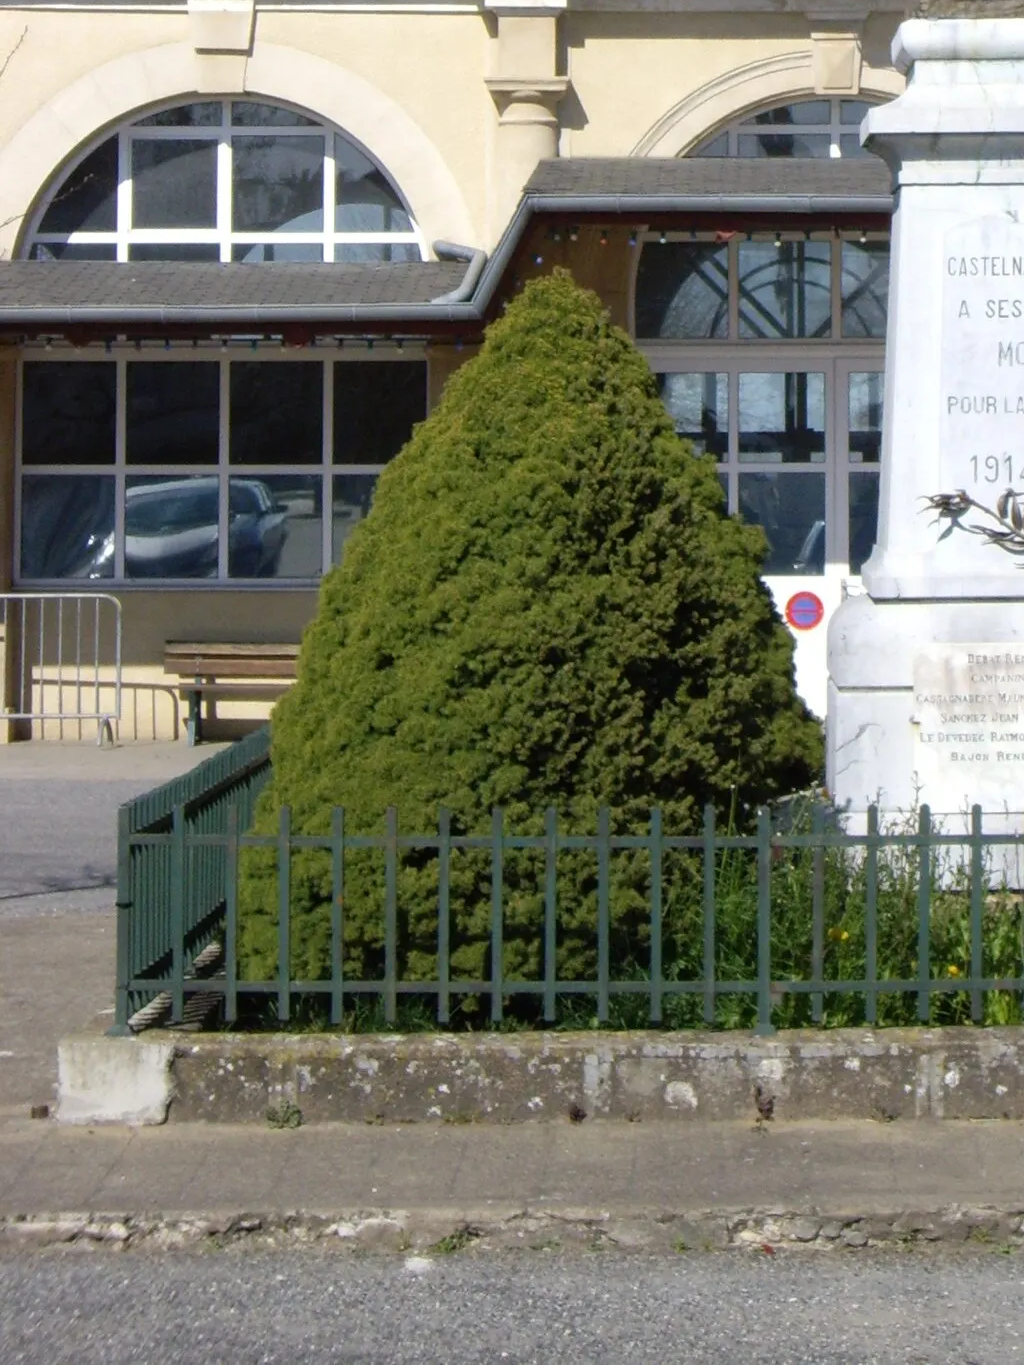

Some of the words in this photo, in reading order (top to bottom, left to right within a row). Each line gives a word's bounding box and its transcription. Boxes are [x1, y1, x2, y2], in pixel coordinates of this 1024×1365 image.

[958, 299, 970, 319] A
[985, 299, 1023, 319] SES
[947, 395, 997, 415] POUR
[919, 732, 934, 743] LE
